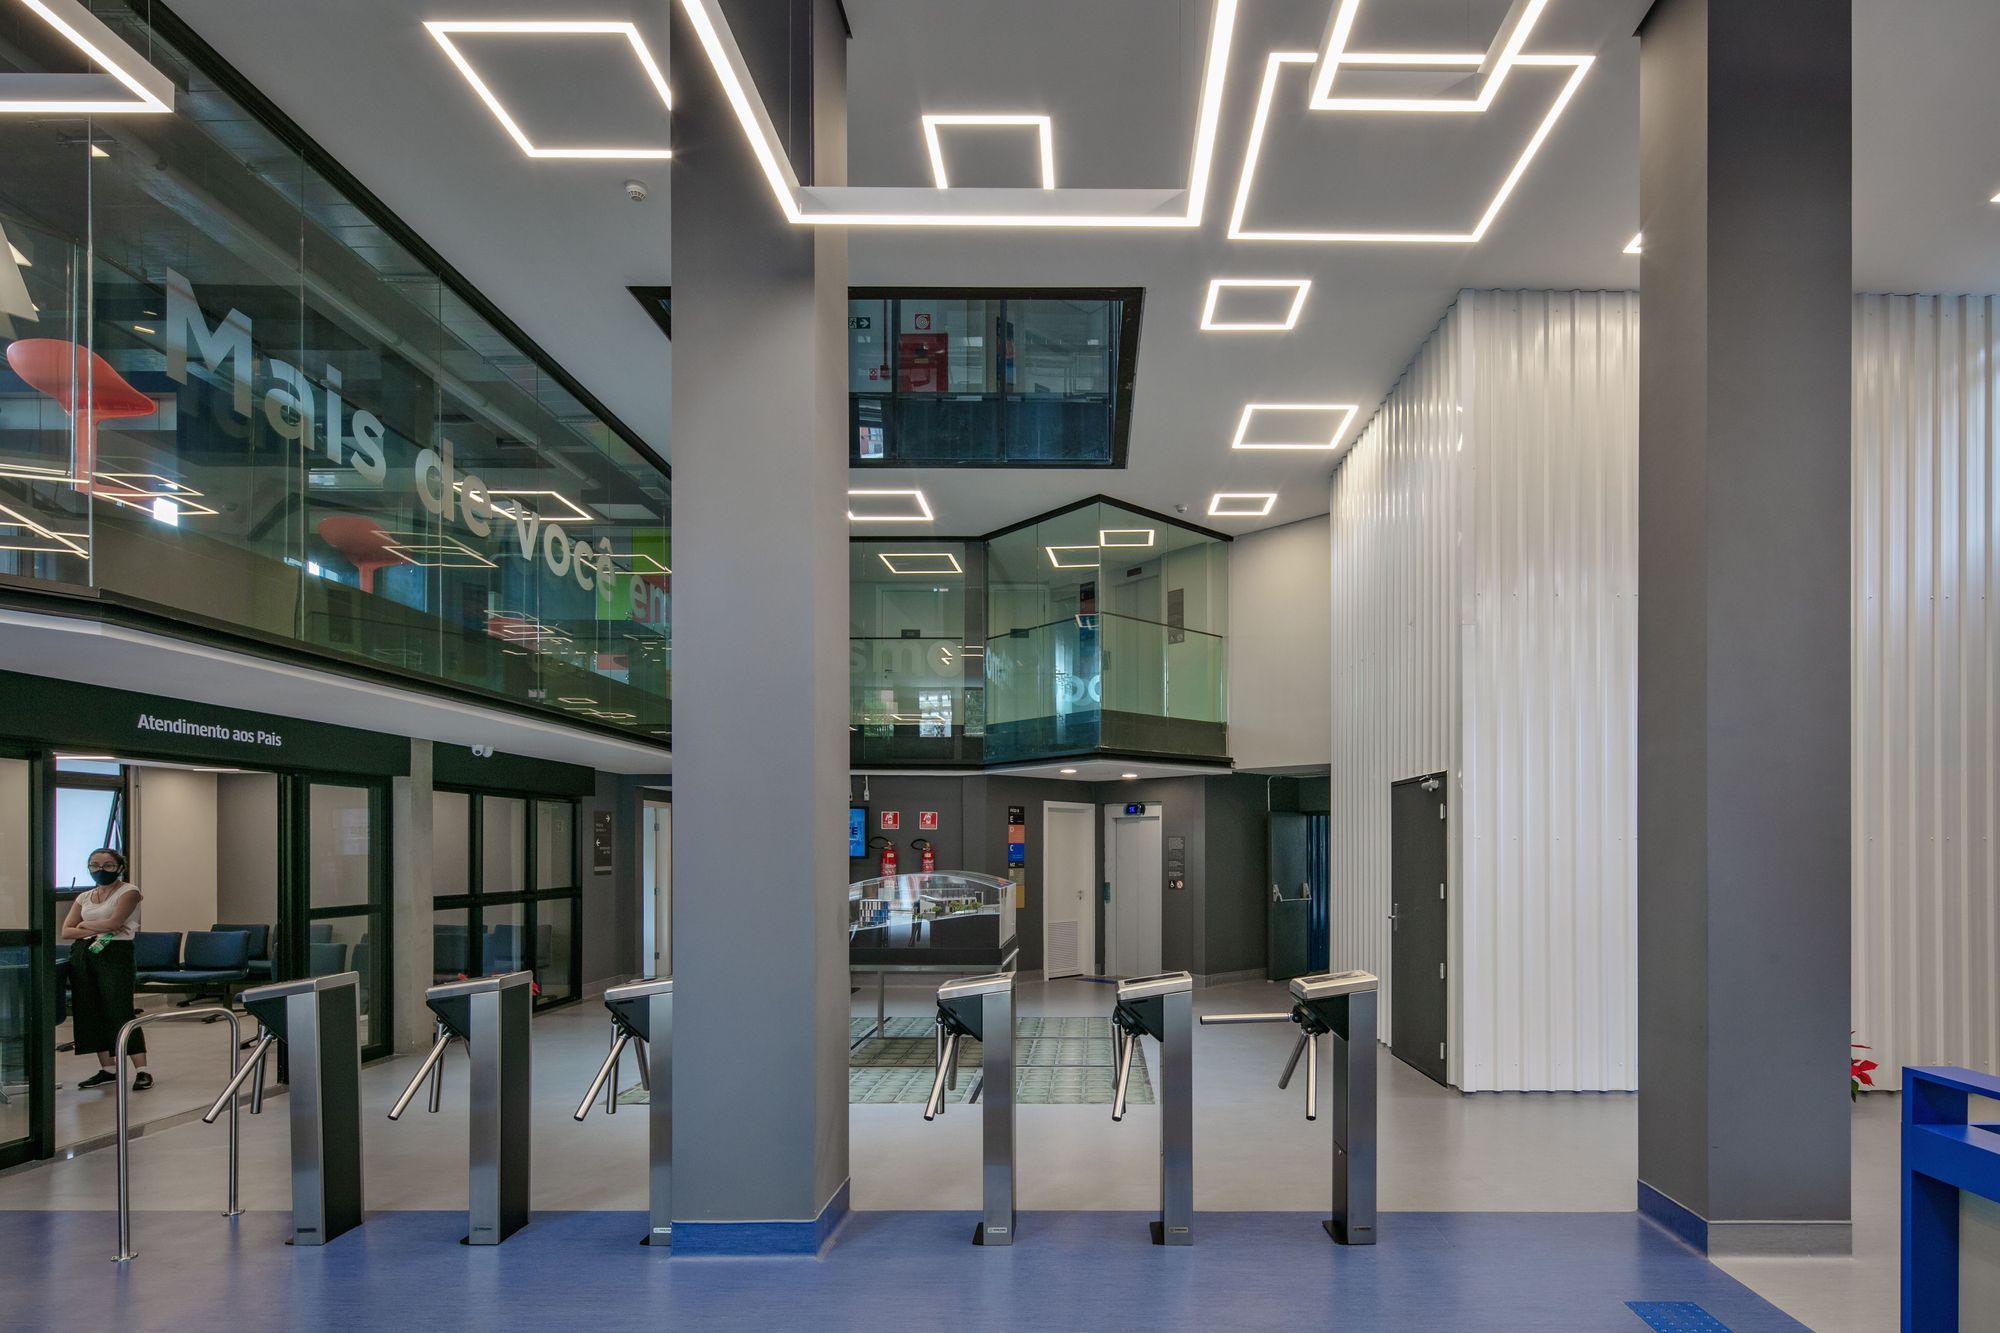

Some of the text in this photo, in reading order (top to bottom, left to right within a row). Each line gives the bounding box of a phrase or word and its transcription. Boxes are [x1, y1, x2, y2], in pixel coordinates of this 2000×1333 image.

[166, 266, 387, 483] Mais
[415, 438, 493, 538] de
[512, 499, 617, 602] você
[137, 713, 282, 747] Atendimento aos Pais
